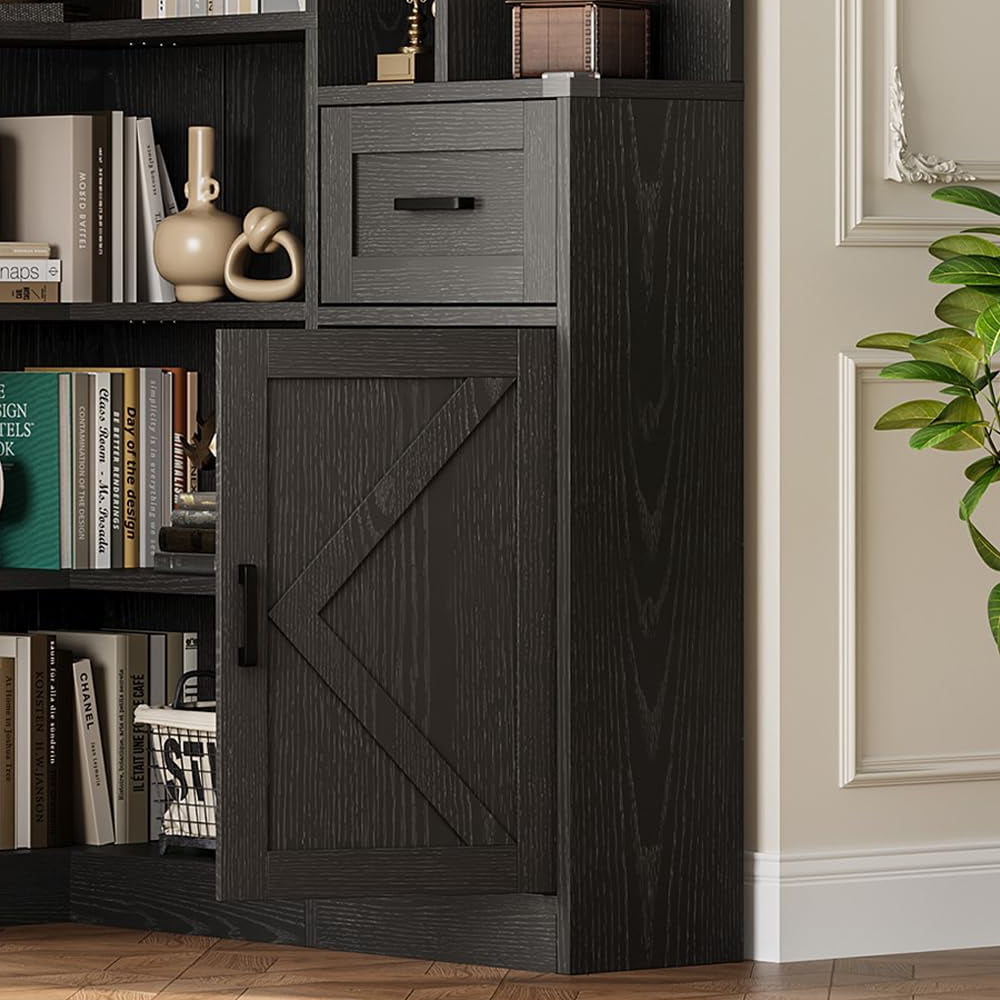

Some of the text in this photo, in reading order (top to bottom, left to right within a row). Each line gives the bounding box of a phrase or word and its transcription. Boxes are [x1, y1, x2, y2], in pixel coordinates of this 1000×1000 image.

[98, 388, 110, 422] Class
[113, 411, 120, 424] BE
[98, 426, 110, 463] Room
[78, 478, 85, 490] OF
[124, 407, 137, 540] Day of the design
[35, 671, 44, 732] KONSTEN
[80, 672, 95, 730] CHANEL
[130, 673, 144, 792] IL ÉTAIT UNE CAFÉ
